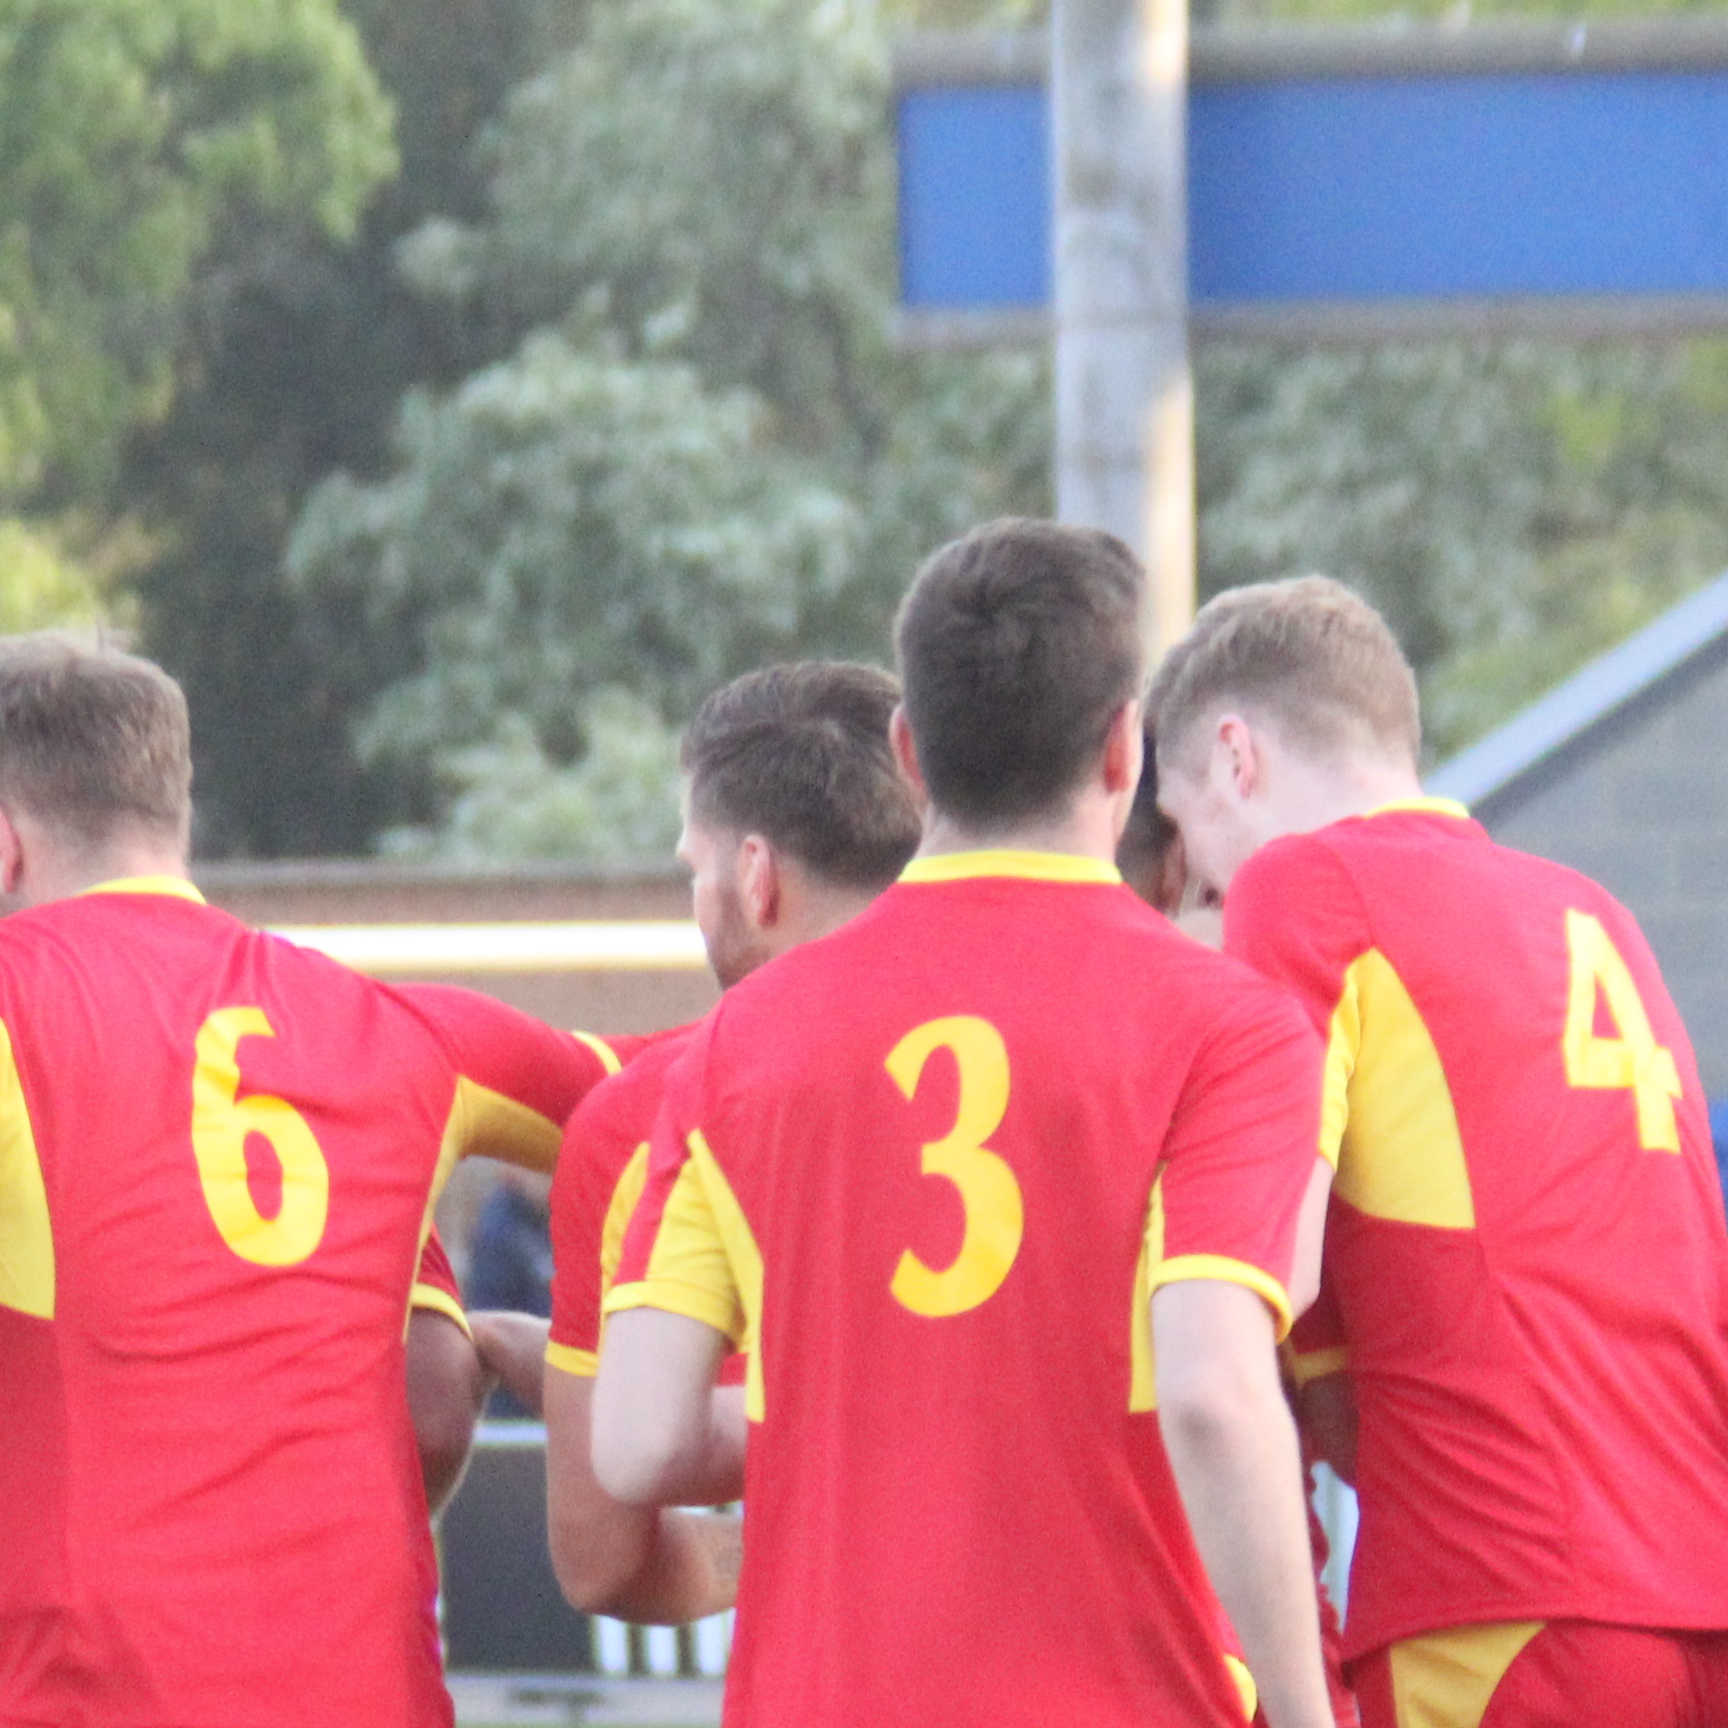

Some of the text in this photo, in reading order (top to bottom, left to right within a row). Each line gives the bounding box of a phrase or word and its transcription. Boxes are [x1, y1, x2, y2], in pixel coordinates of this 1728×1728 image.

[192, 1006, 329, 1266] 6
[1563, 907, 1682, 1154] 4
[884, 1016, 1023, 1317] 3
